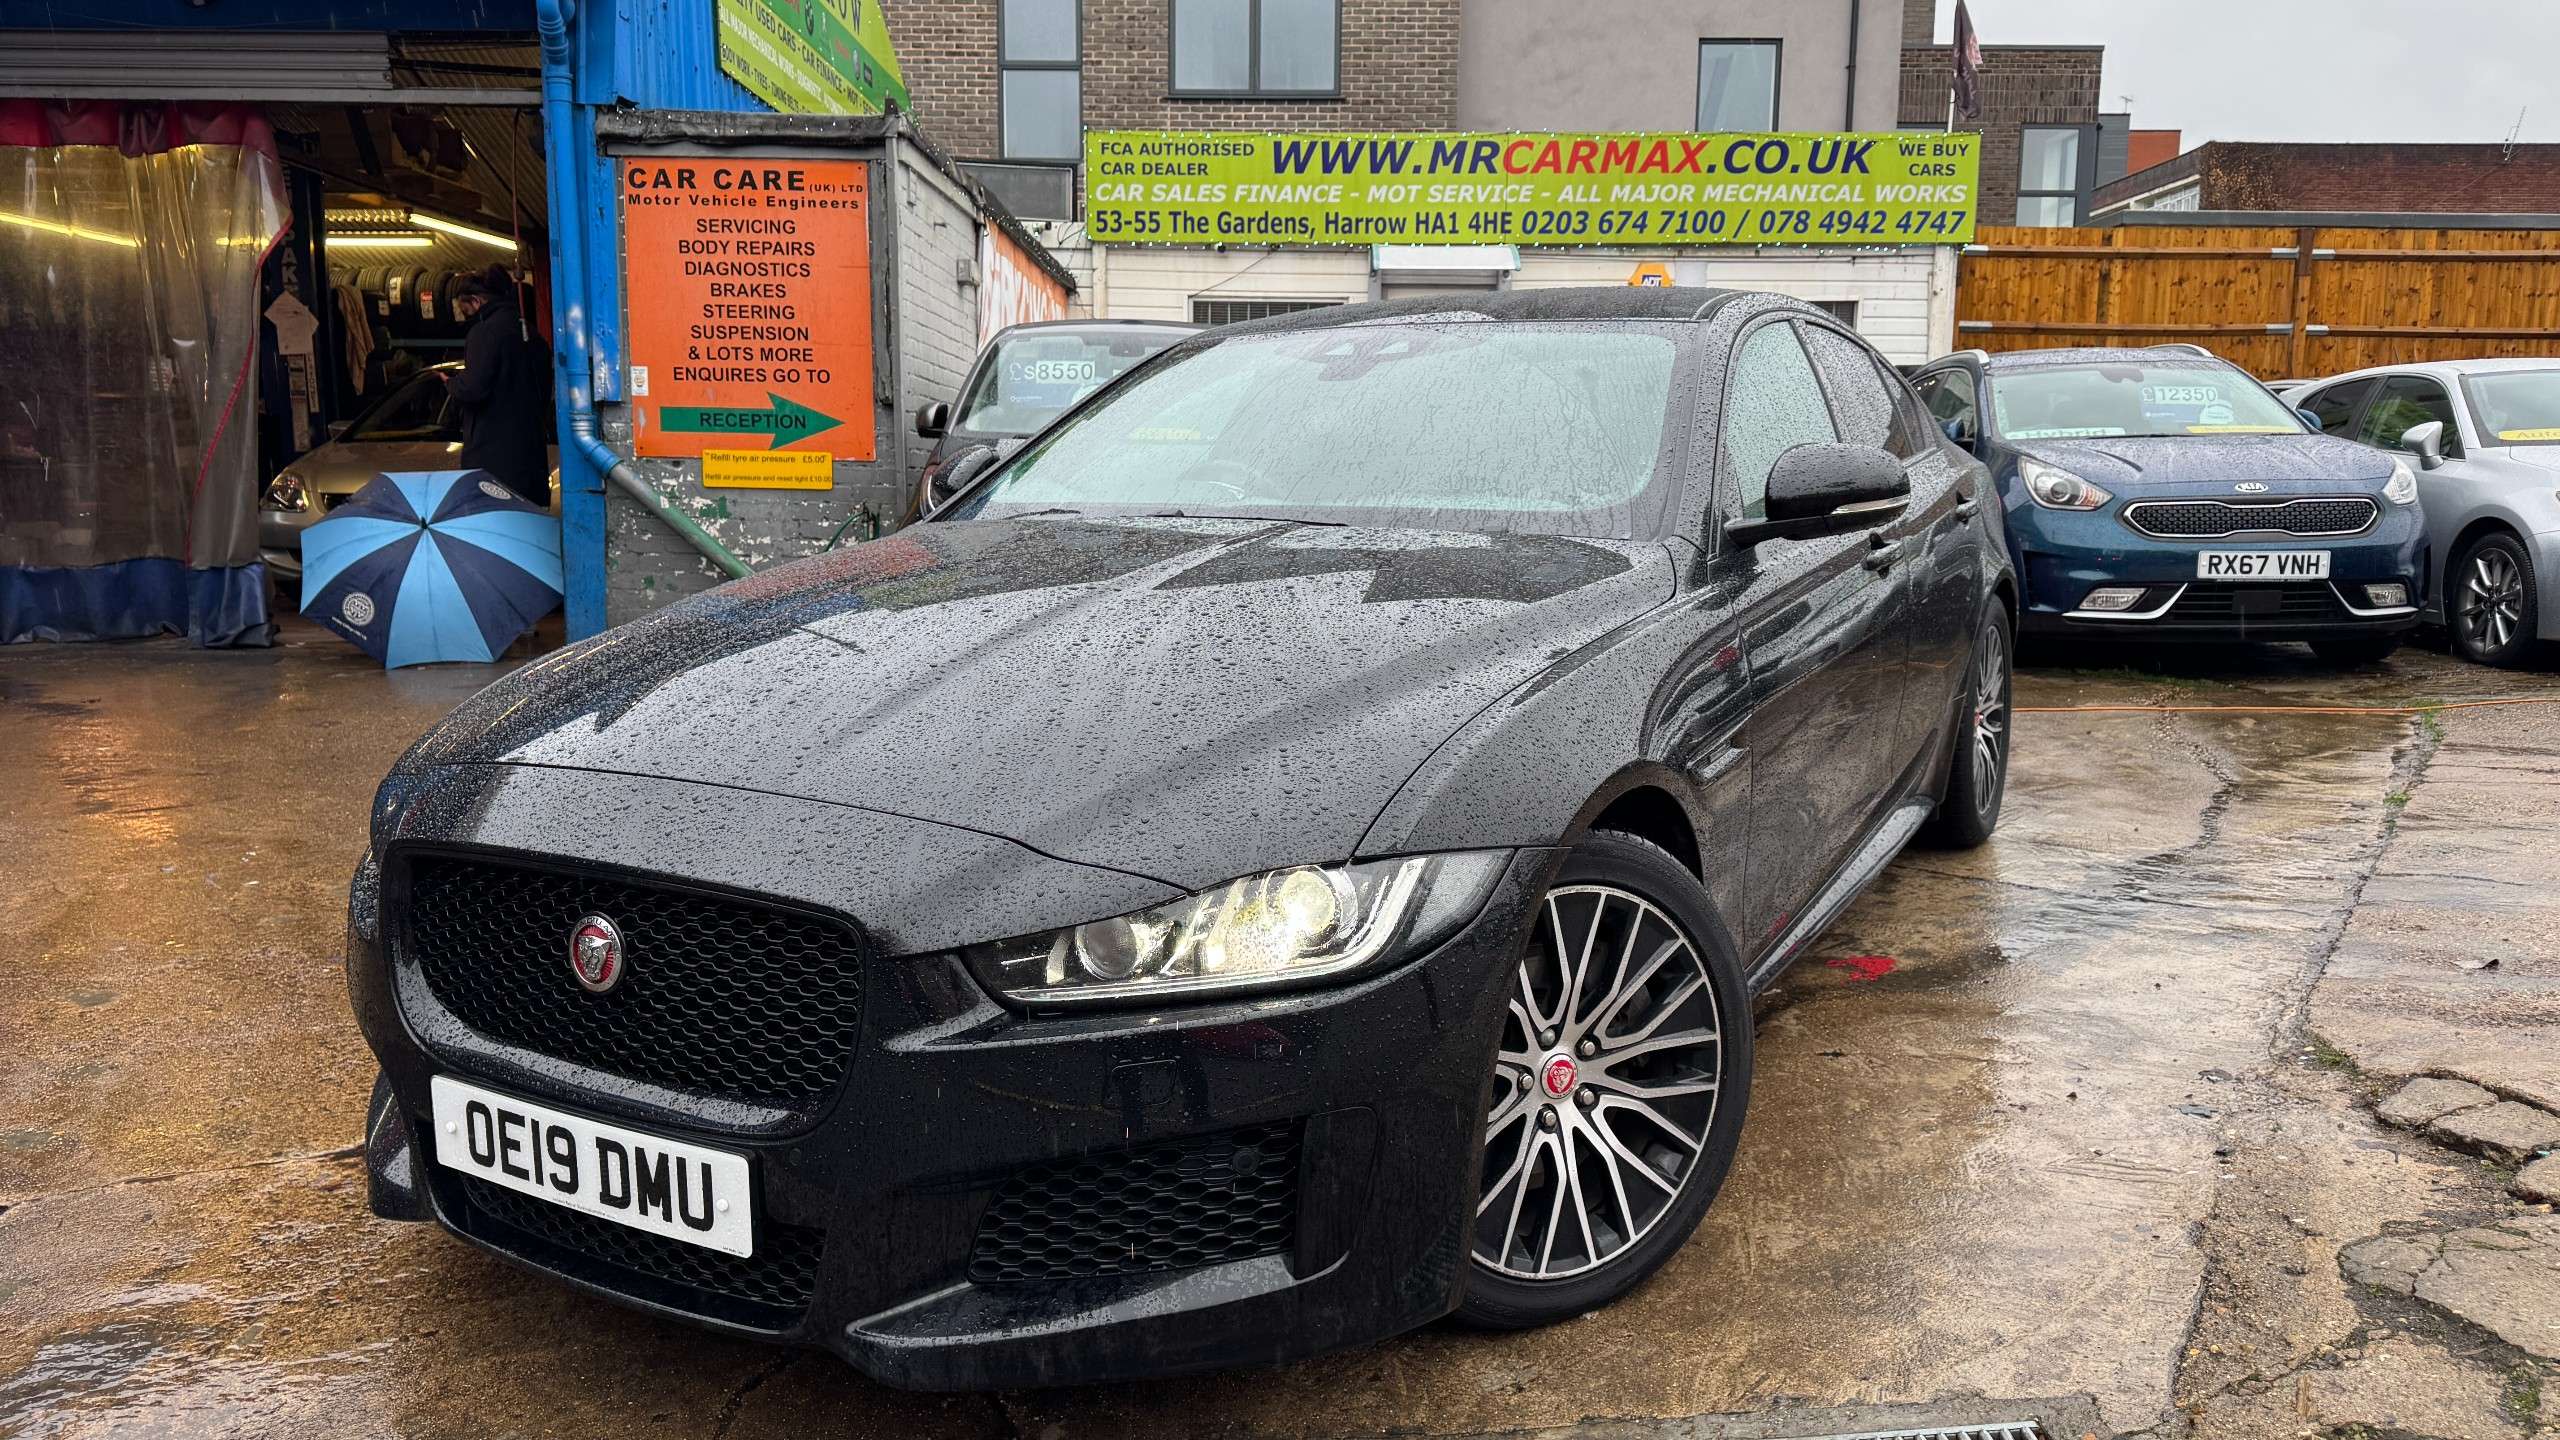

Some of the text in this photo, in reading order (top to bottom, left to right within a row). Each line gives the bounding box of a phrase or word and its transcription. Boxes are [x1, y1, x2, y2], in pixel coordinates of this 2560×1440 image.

[1102, 143, 1254, 156] FCA AUTHORISED
[1270, 138, 1880, 176] WWW.MRCARMAX.CO.UK
[1899, 144, 1968, 156] WE BUY
[1101, 162, 1208, 175] CAR DEALER
[1909, 164, 1955, 176] CARS
[628, 168, 866, 194] CAR CARE (UK) LTD
[1095, 184, 1144, 202] CAR
[1151, 184, 1227, 202] SALES
[1234, 184, 1342, 202] FINANCE
[1367, 184, 1417, 203] MOT
[1427, 184, 1533, 203] SERVICE
[1557, 184, 1602, 203] ALL
[1611, 184, 1697, 203] MAJOR
[1702, 184, 1866, 203] MECHANICAL
[1874, 184, 1968, 203] WORKS
[629, 194, 858, 210] Motor Vehicle Engineers
[697, 219, 795, 234] SERVICING
[1097, 210, 1966, 239] 53-55 The Gardens, Harrow HA1 4HE 0203 674 7100 / 078 4942 4747
[679, 240, 815, 256] BODY REPAIRS
[685, 261, 810, 277] DIAGNOSTICS
[1641, 276, 1661, 287] ADT
[711, 283, 786, 298] BRAKES
[704, 304, 795, 319] STEERING
[691, 325, 808, 341] SUSPENSION
[689, 346, 813, 362] & LOTS MORE
[673, 367, 830, 383] ENQUIRES GO TO
[698, 411, 808, 431] RECEPTION
[732, 454, 748, 463] tyre
[761, 455, 796, 464] pressure
[2208, 555, 2320, 574] RX67 VNH
[464, 1098, 715, 1233] OE19 DMU
